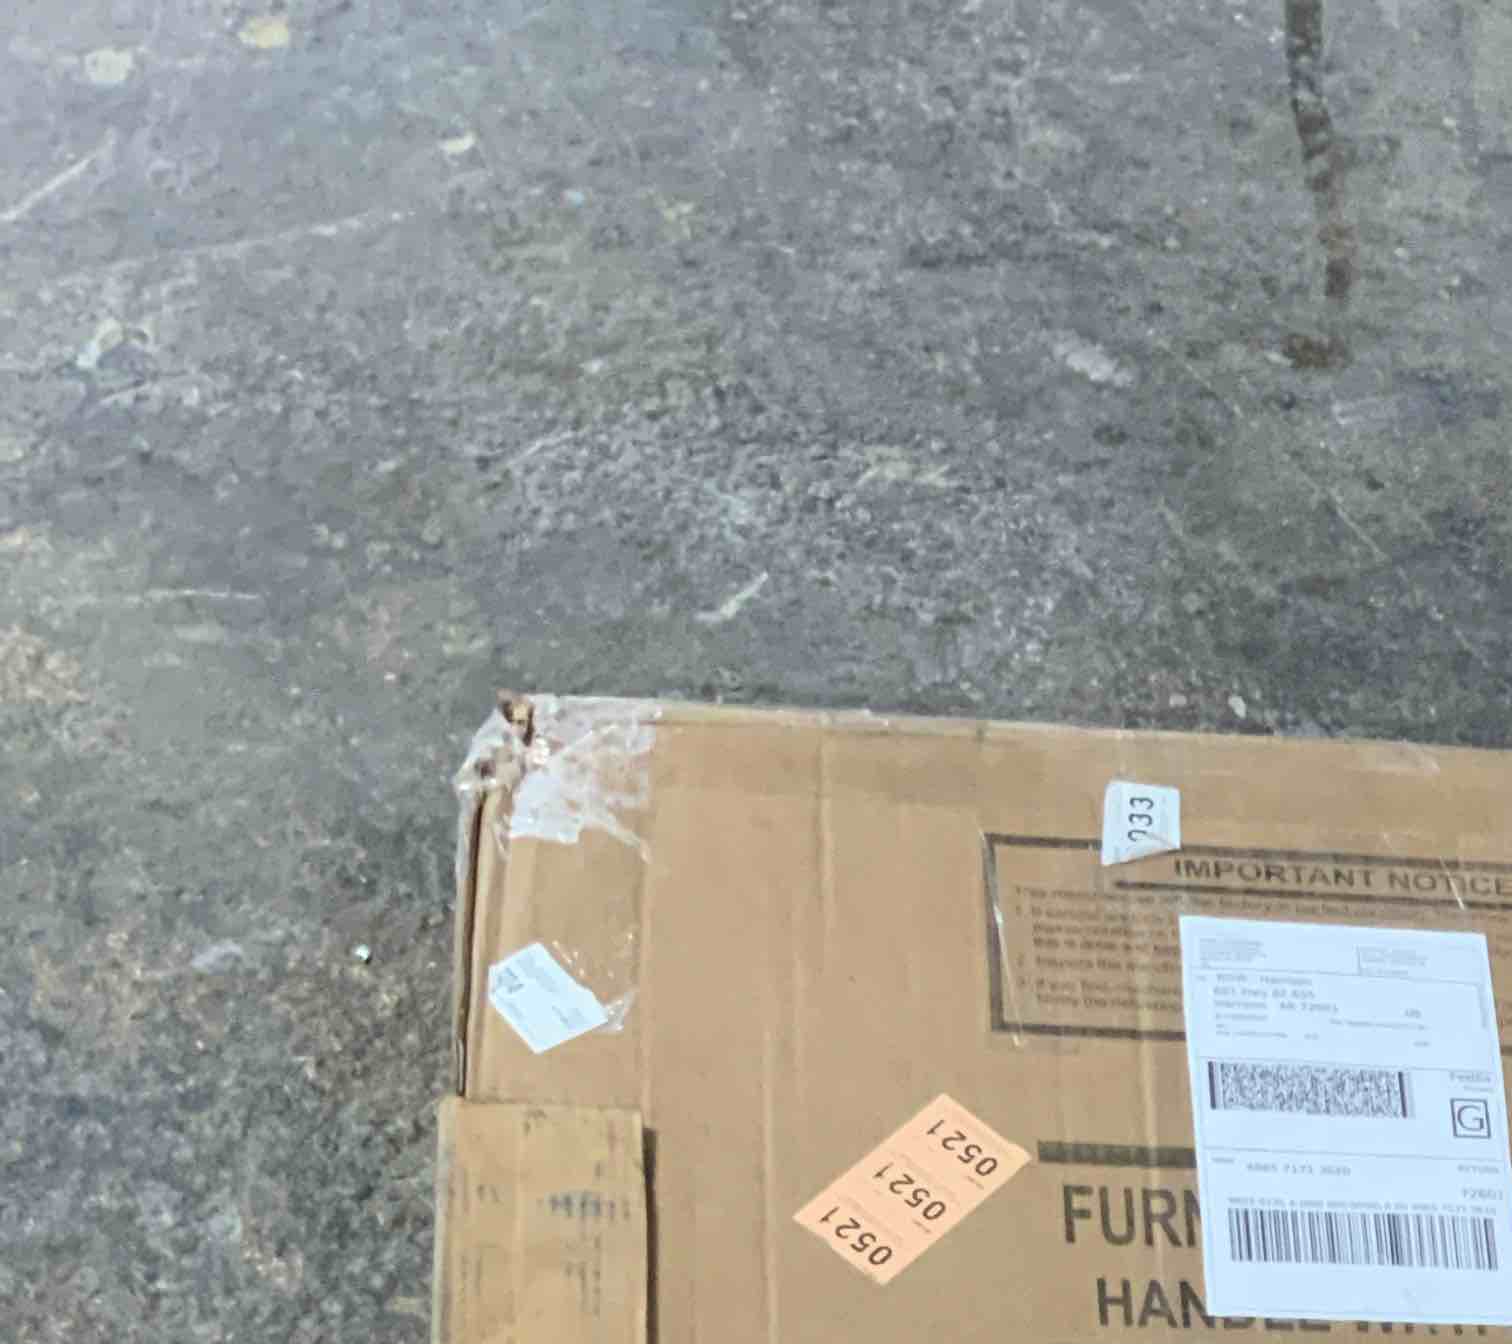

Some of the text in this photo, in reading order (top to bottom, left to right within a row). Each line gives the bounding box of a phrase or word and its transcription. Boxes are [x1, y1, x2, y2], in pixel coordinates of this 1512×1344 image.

[1174, 859, 1375, 889] IMPORTANT
[1457, 1105, 1485, 1132] G
[926, 1119, 998, 1177] 0521
[873, 1161, 947, 1221] 0521
[819, 1206, 893, 1266] 0521
